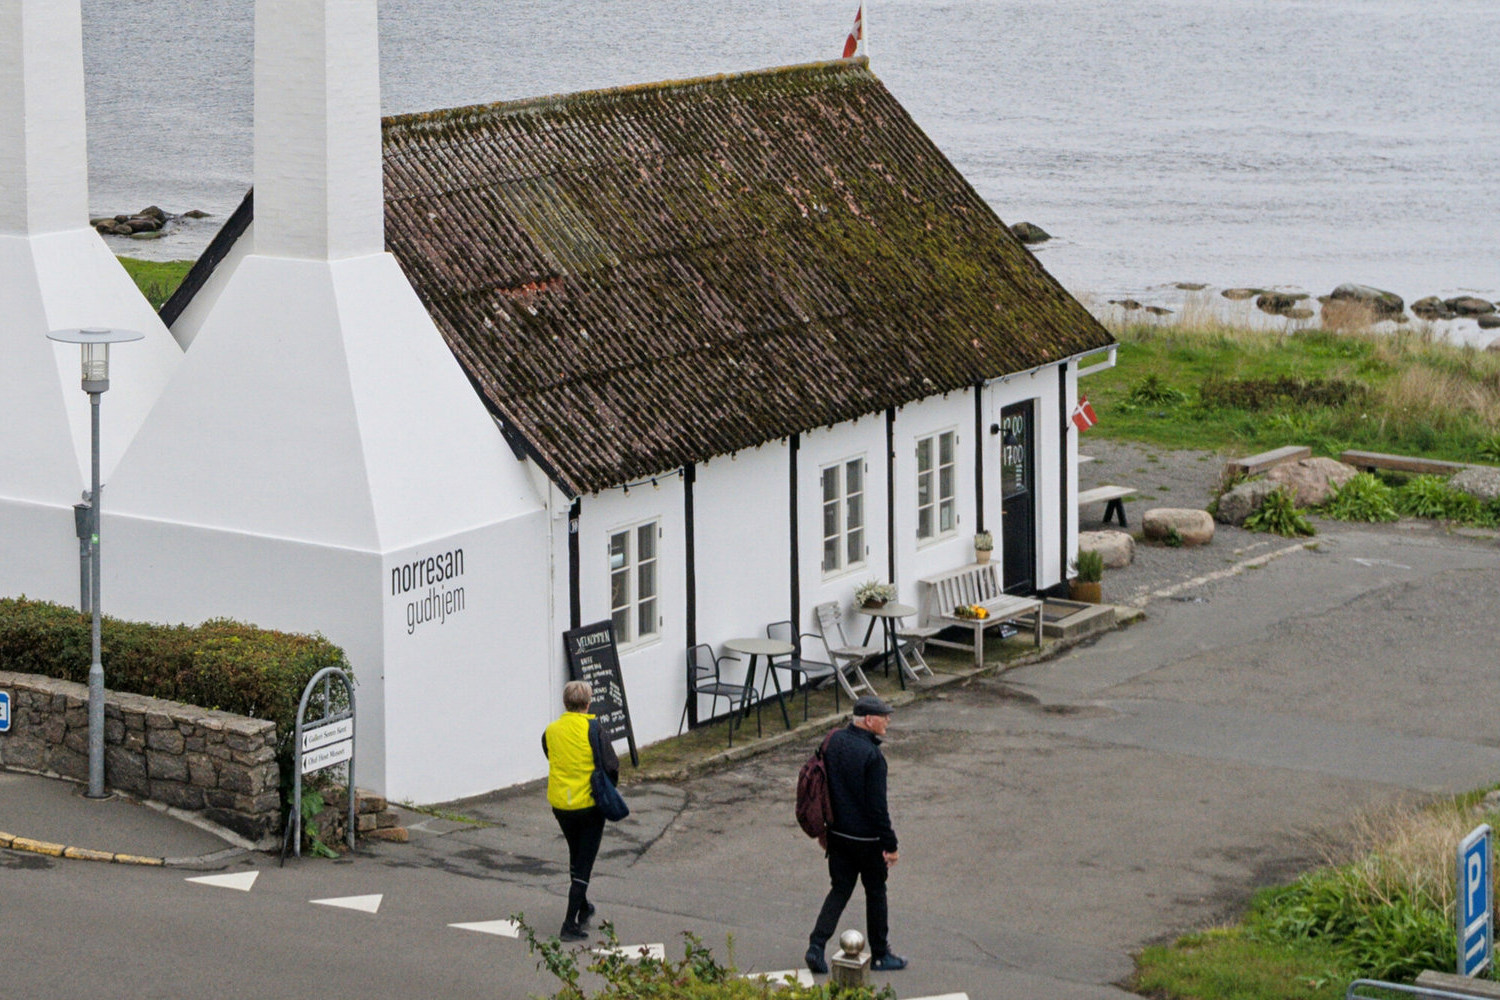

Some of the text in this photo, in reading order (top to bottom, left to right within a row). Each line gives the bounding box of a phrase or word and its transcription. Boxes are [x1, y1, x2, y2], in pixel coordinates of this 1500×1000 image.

[391, 548, 464, 596] norresan
[406, 584, 465, 635] gudhjem
[1468, 851, 1482, 917] P
